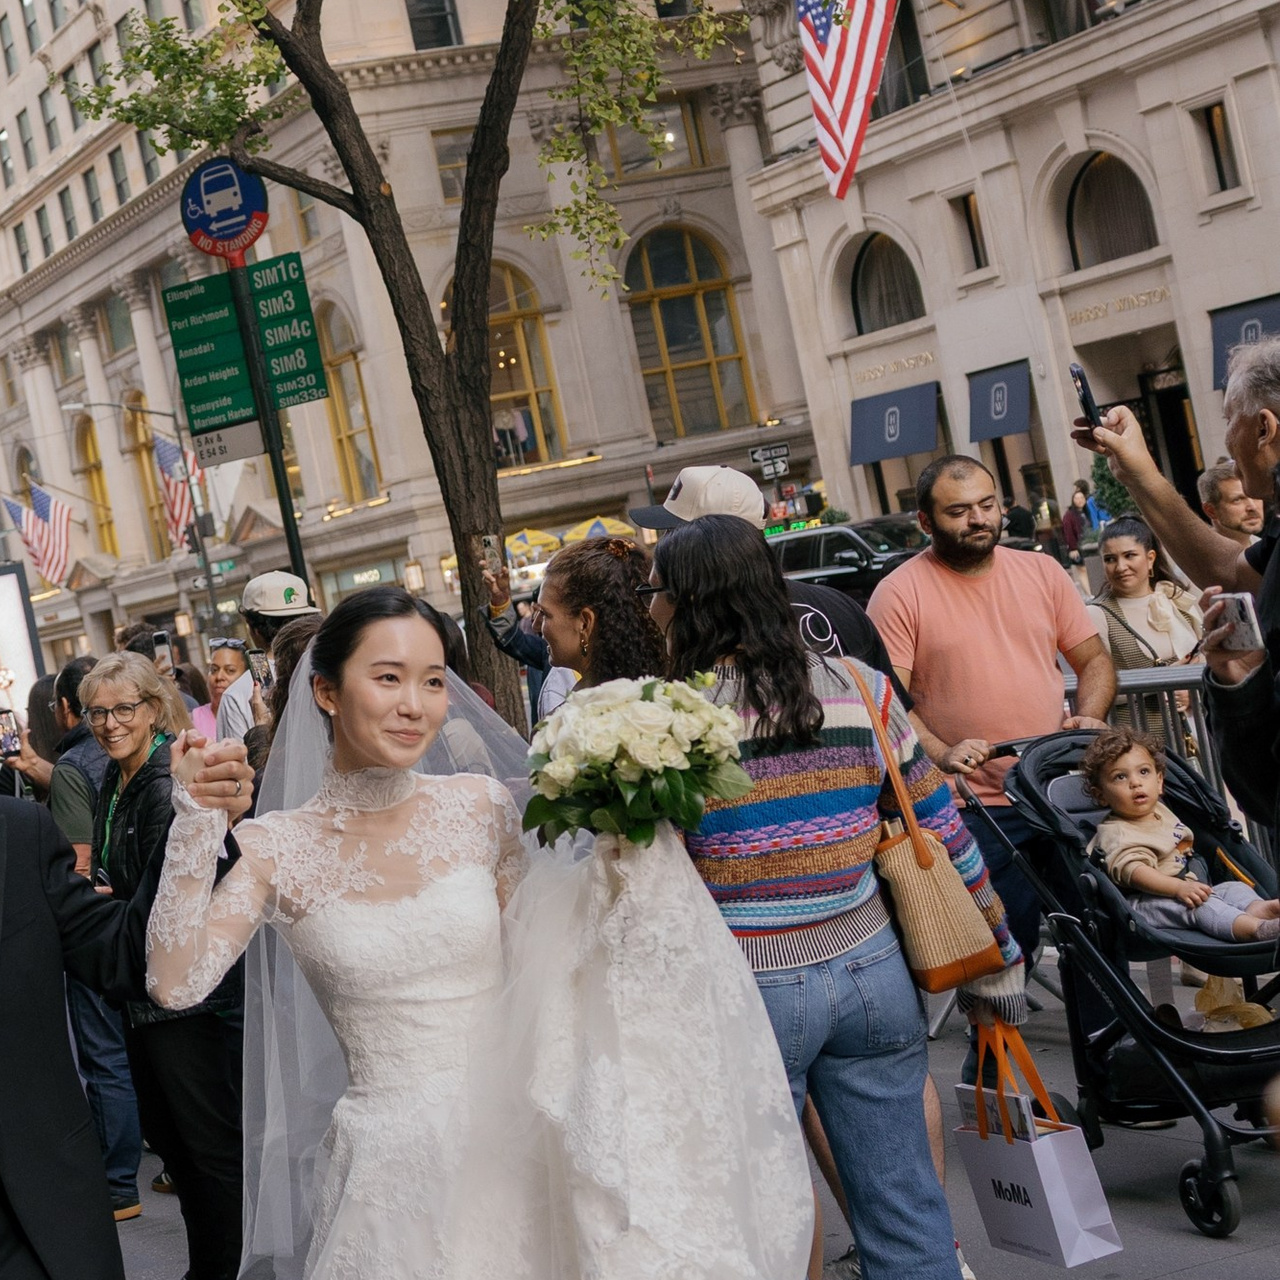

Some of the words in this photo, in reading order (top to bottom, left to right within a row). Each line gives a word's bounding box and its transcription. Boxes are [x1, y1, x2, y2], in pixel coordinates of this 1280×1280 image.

[197, 235, 213, 252] NO
[216, 219, 263, 253] STANDING
[166, 284, 205, 303] Eltingville
[259, 290, 295, 318] SIM3
[1070, 302, 1109, 326] HARRY
[1114, 285, 1172, 312] WINSTON
[171, 318, 189, 331] Port
[189, 306, 230, 326] Richmond
[178, 342, 215, 359] Annadale
[271, 348, 307, 375] SIM8
[184, 374, 207, 388] Arden
[208, 366, 239, 382] Heights
[276, 374, 316, 394] SIM30
[190, 396, 232, 414] Sunnyside
[193, 413, 227, 430] Mariners
[227, 407, 253, 421] Harbor
[197, 438, 203, 447] 5
[204, 435, 214, 446] Av
[216, 433, 222, 442] &
[199, 451, 206, 460] E
[207, 448, 217, 458] 54
[218, 445, 227, 455] St
[991, 1178, 1033, 1209] MoMA
